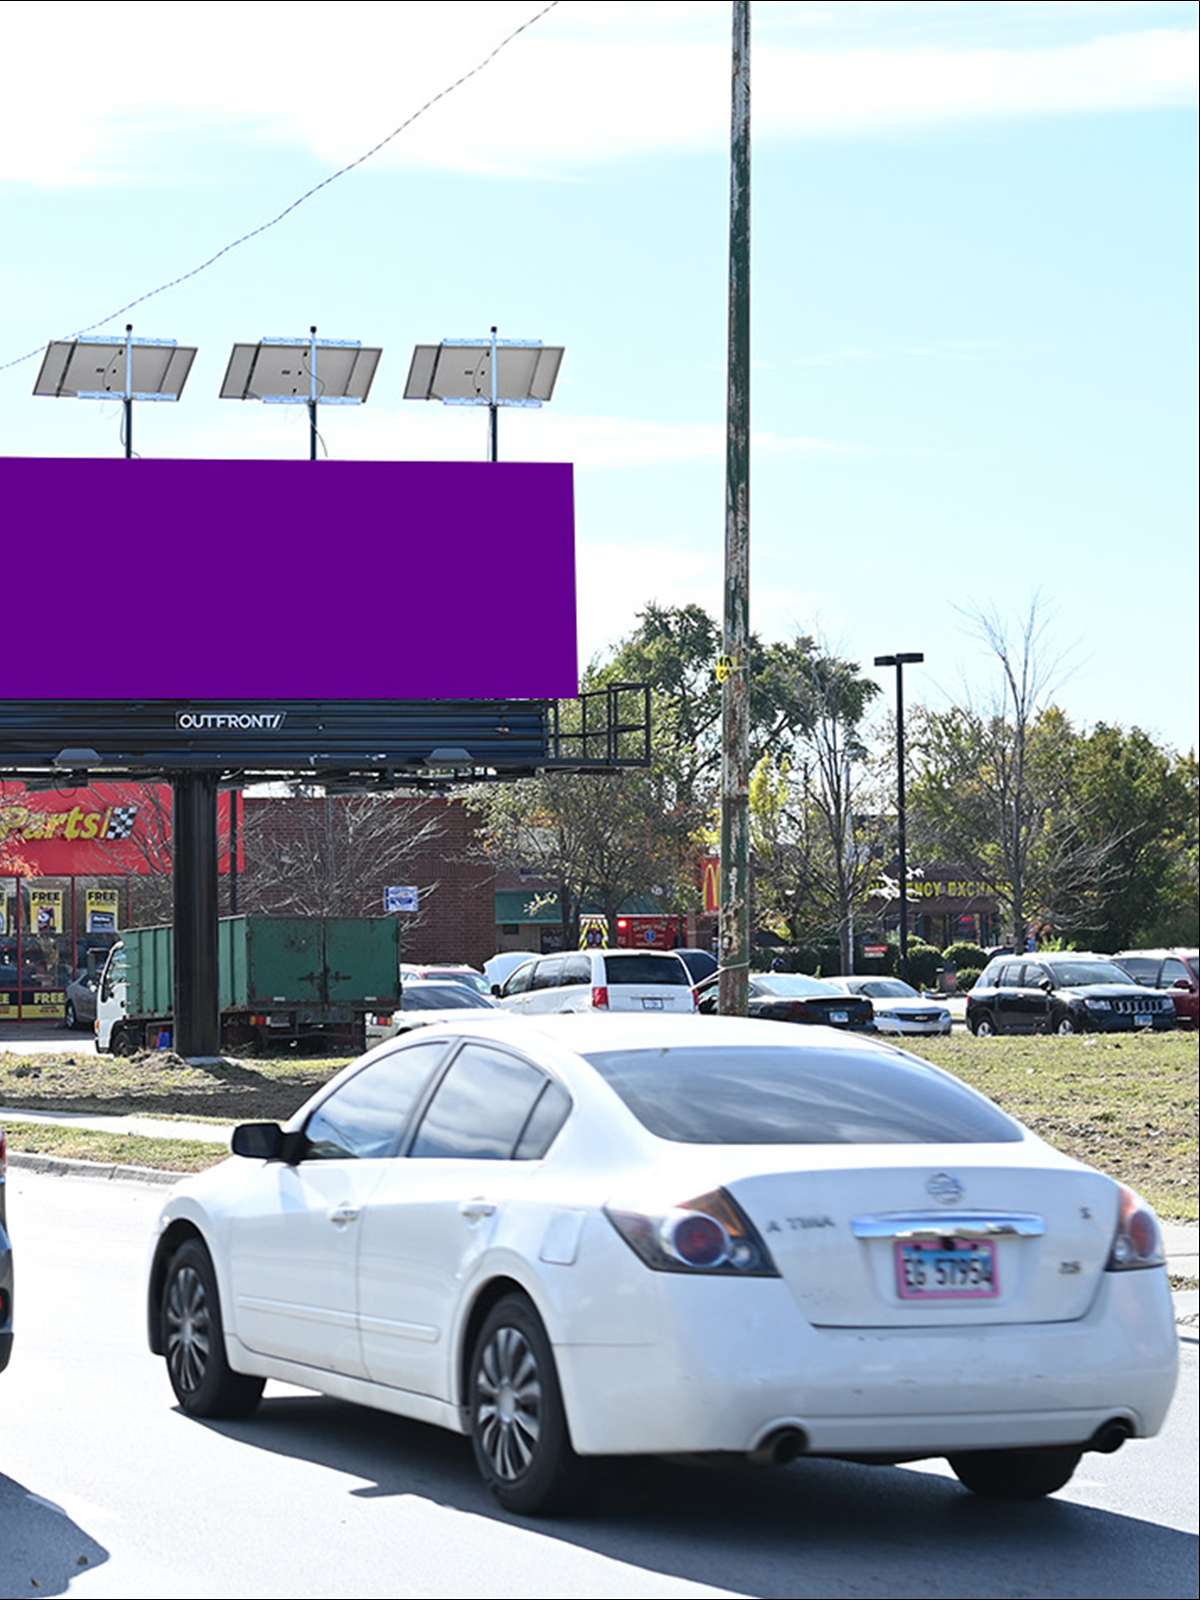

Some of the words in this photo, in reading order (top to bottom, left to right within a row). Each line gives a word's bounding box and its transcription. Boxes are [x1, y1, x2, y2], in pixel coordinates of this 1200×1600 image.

[32, 891, 61, 901] FREE
[88, 891, 117, 901] FREE
[33, 992, 66, 1004] FREE
